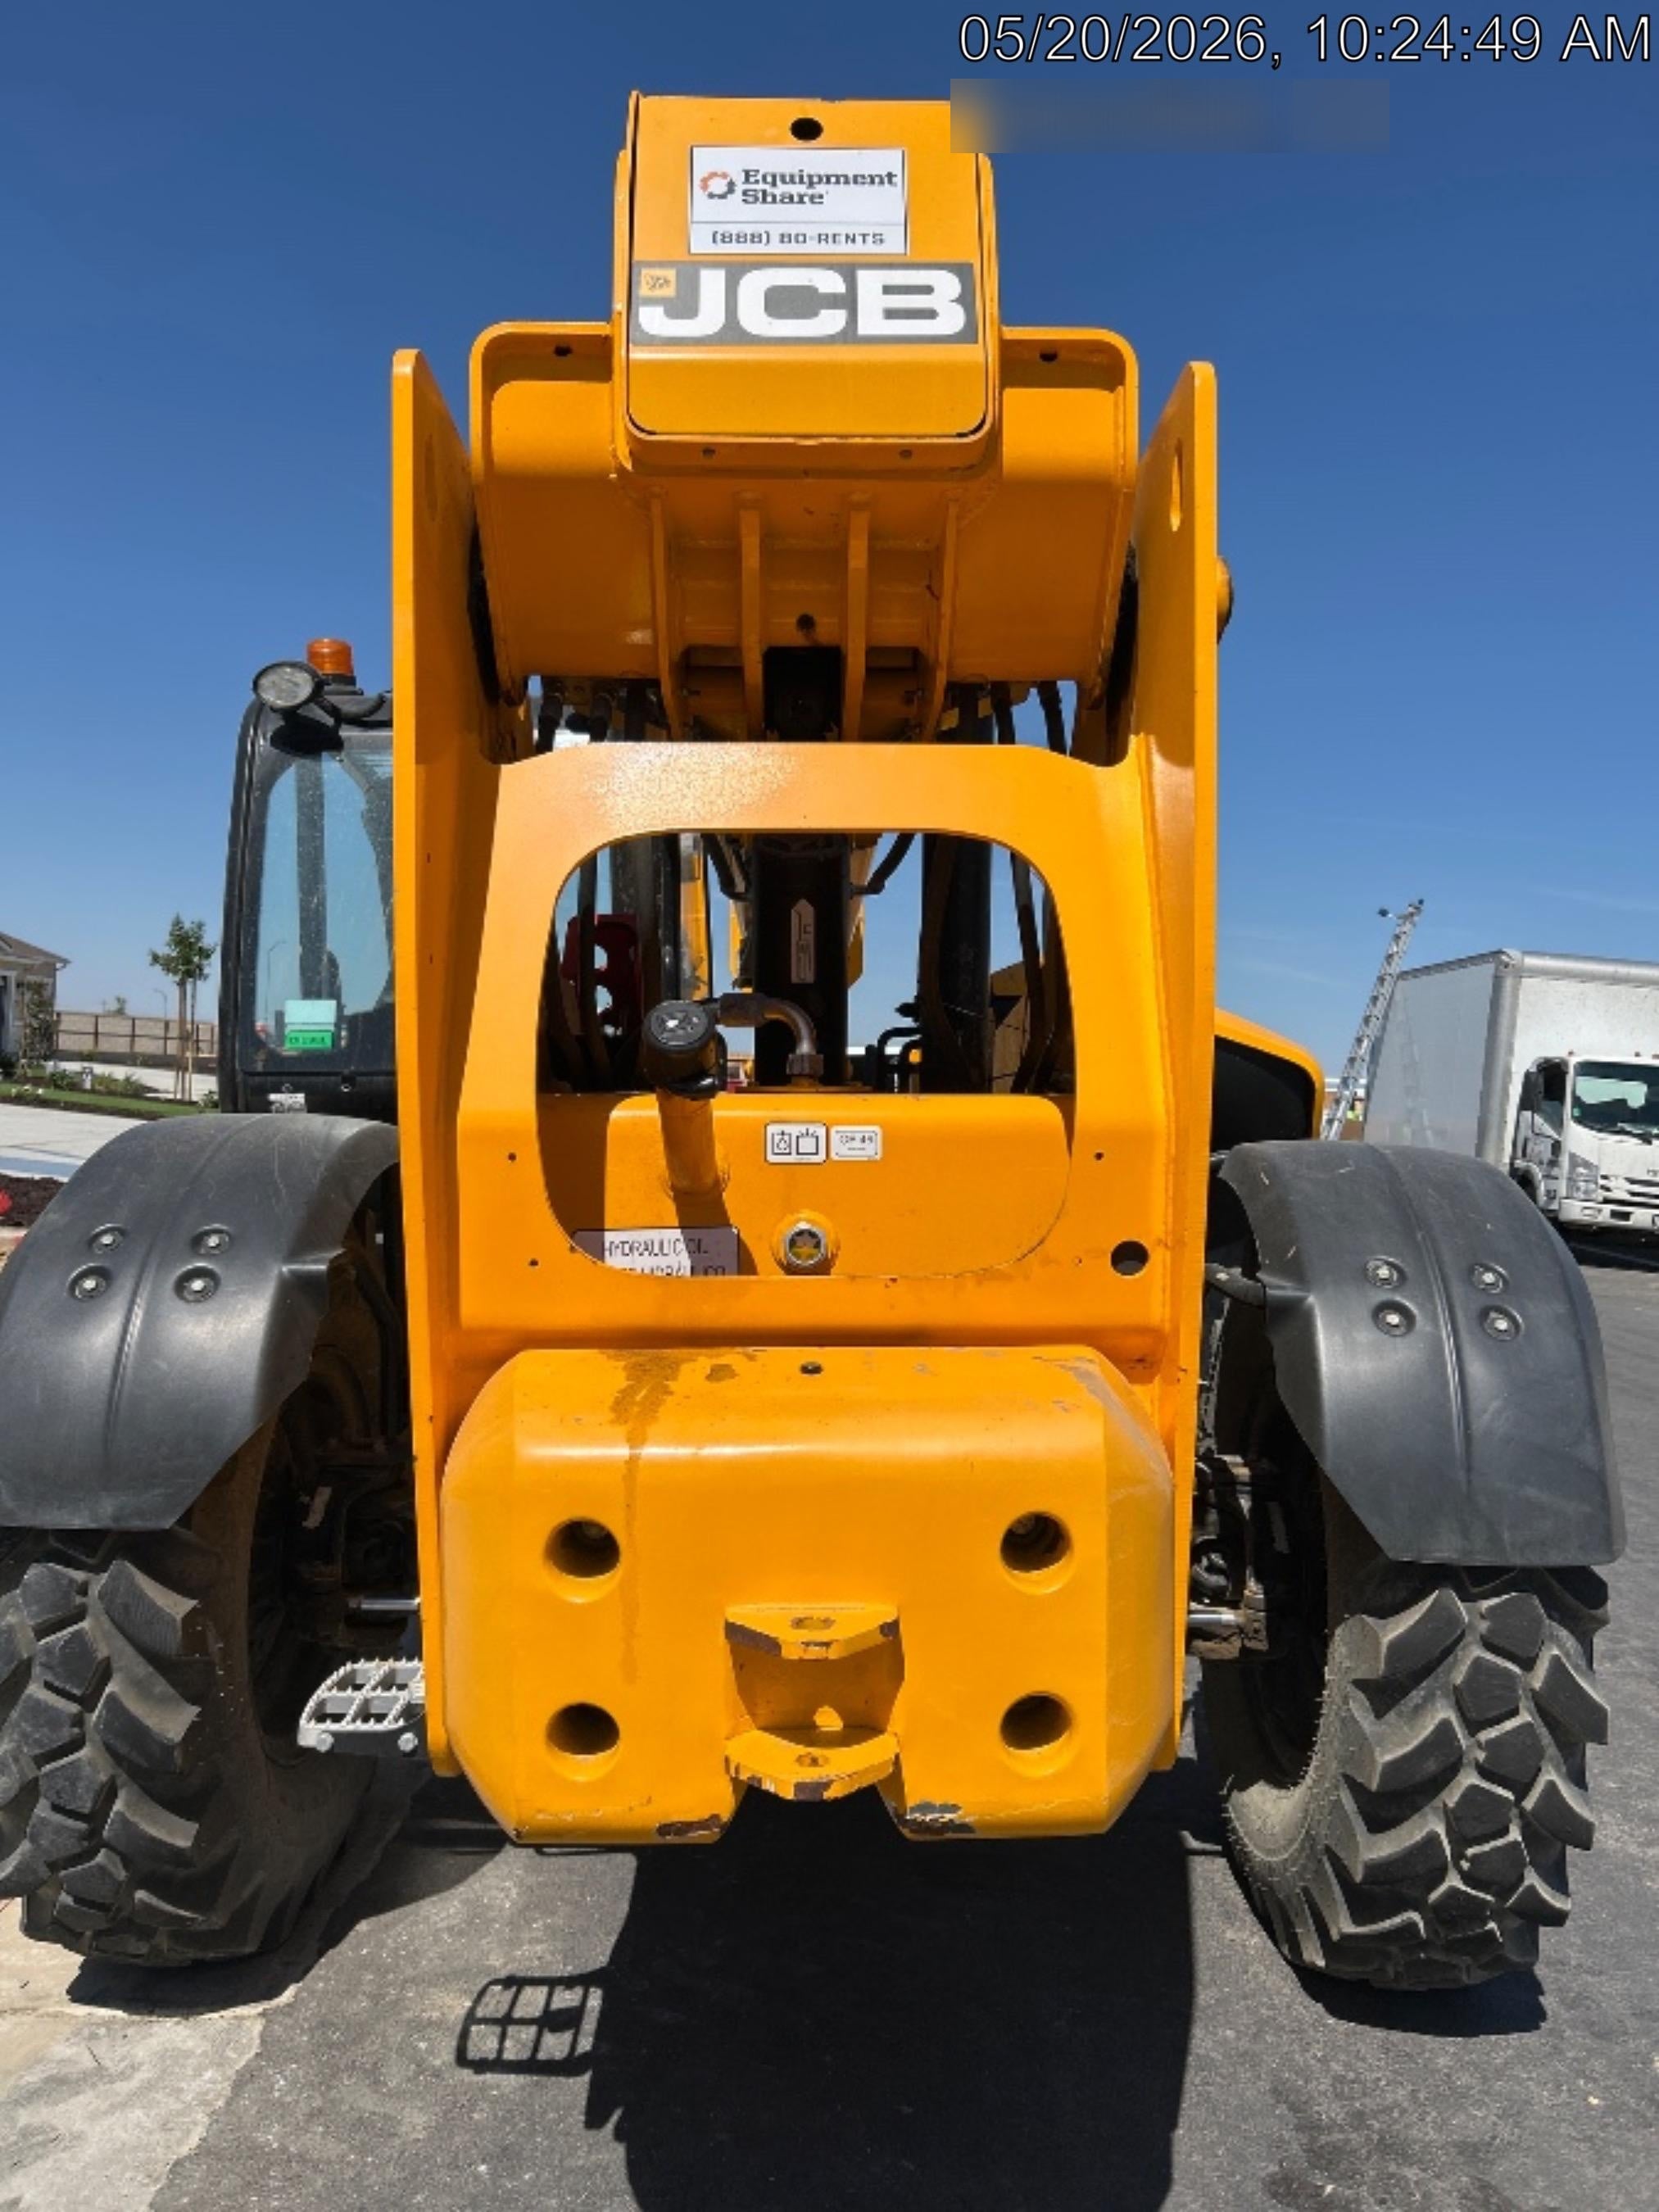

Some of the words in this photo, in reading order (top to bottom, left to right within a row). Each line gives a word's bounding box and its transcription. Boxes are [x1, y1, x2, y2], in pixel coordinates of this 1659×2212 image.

[741, 169, 898, 188] Equipment
[741, 188, 824, 205] Share
[712, 230, 771, 246] (888)
[779, 232, 886, 245] 80-RENTS
[638, 268, 967, 338] JCB
